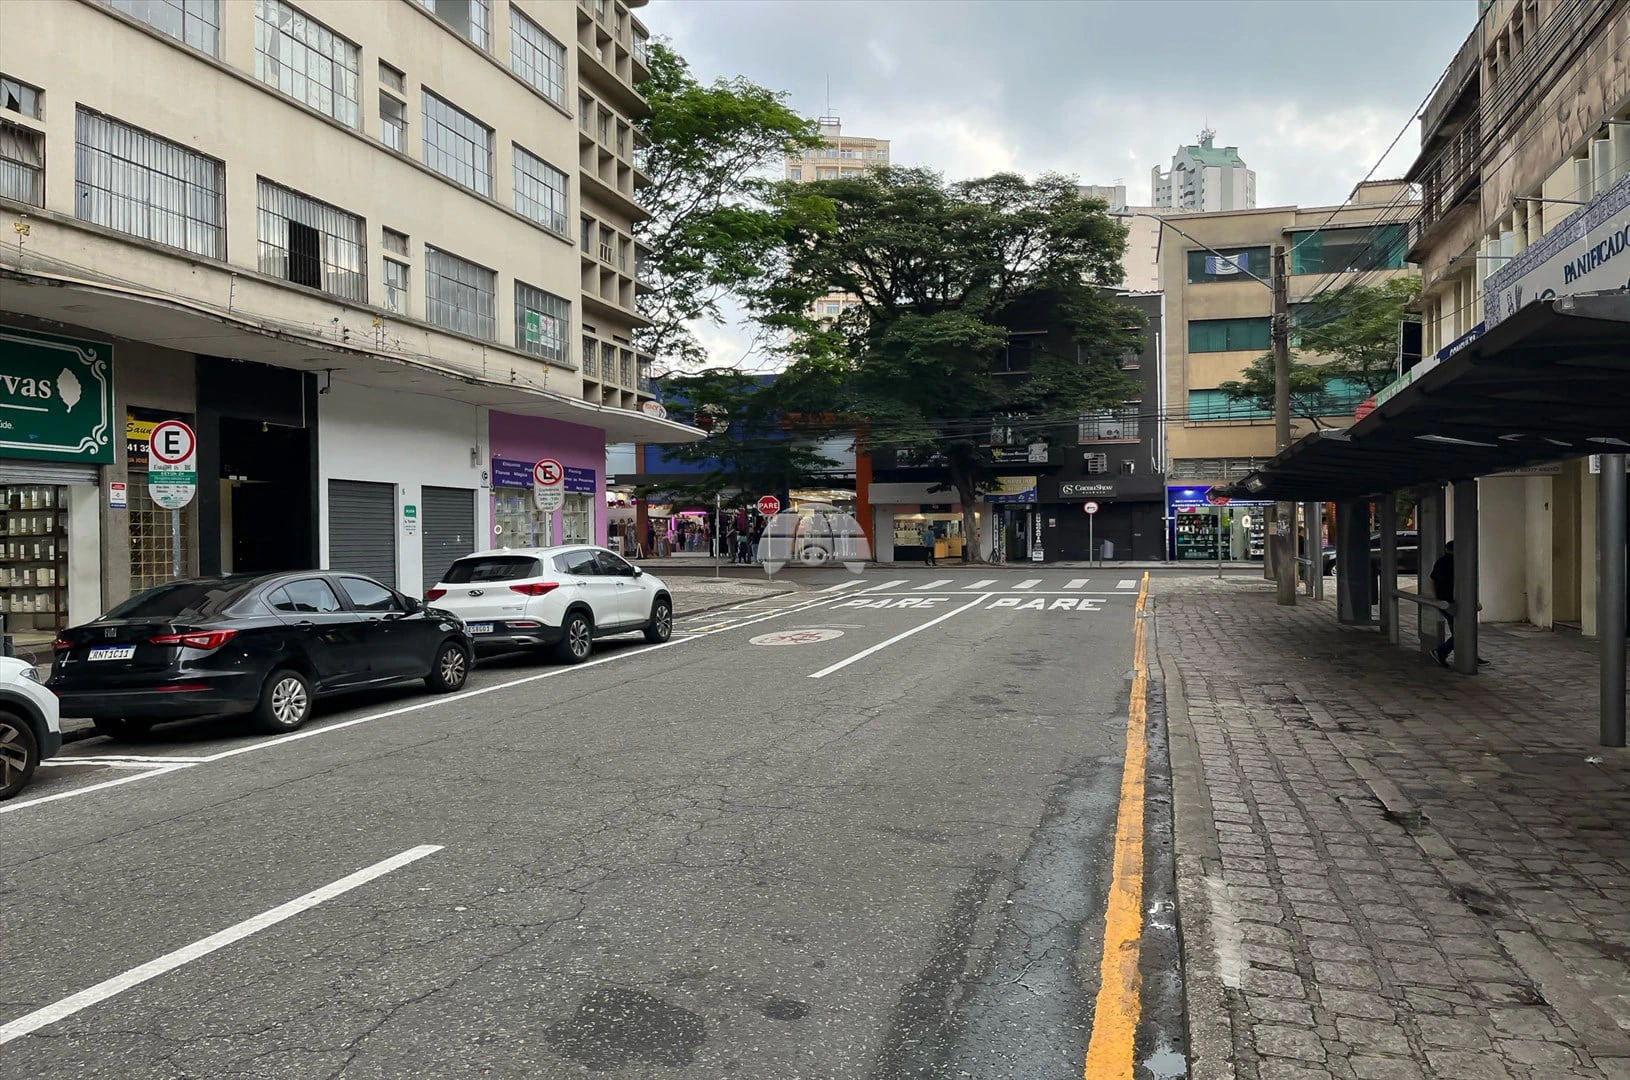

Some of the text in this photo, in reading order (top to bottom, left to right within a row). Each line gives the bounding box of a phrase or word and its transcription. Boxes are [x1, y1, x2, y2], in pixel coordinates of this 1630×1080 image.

[127, 443, 138, 452] 41
[165, 431, 180, 455] E
[828, 598, 949, 610] PARE
[984, 598, 1107, 611] PARE
